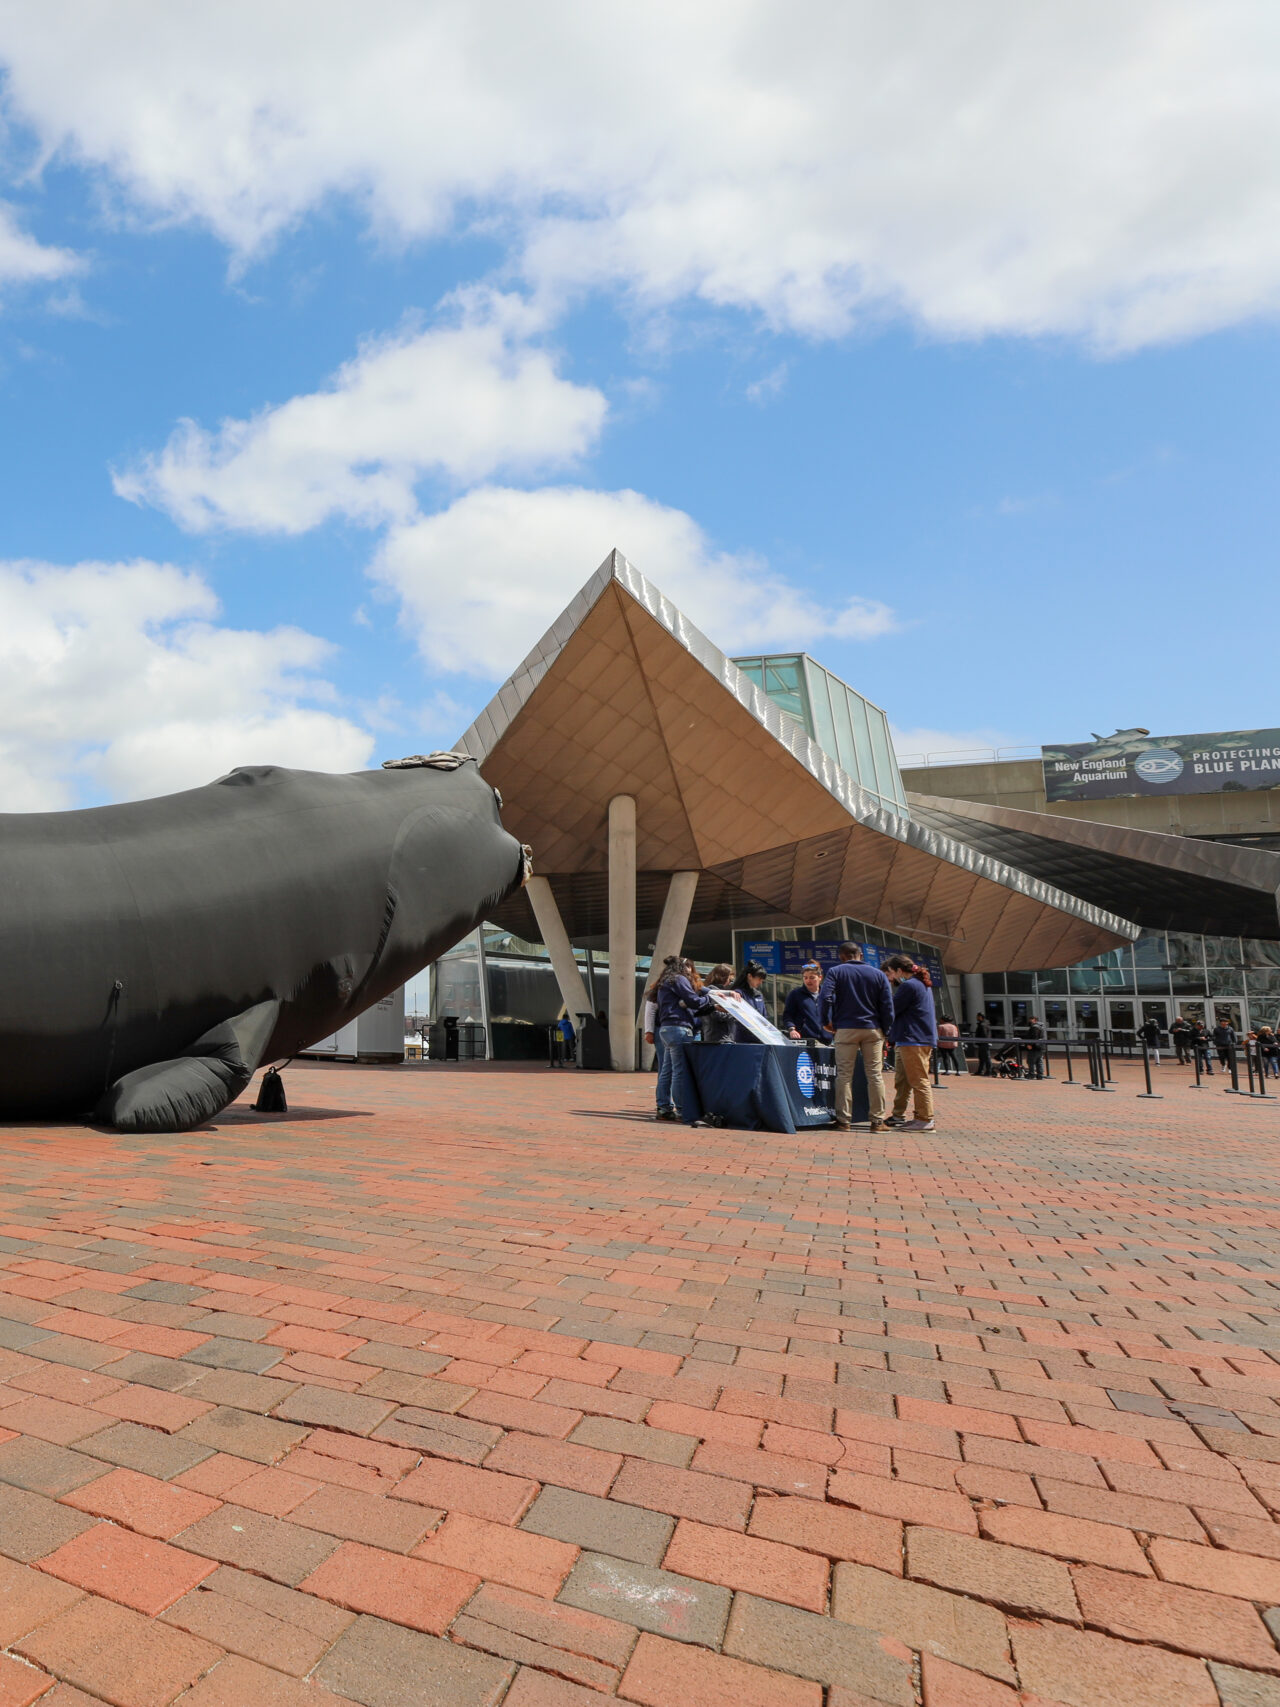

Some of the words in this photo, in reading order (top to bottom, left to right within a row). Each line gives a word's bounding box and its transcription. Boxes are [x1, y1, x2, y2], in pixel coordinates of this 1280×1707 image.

[1192, 747, 1280, 761] PROTECTING
[1055, 762, 1079, 772] New
[1082, 757, 1127, 771] England
[1193, 761, 1234, 774] BLUE
[1240, 758, 1280, 772] PLAN
[1073, 770, 1128, 783] Aquarium
